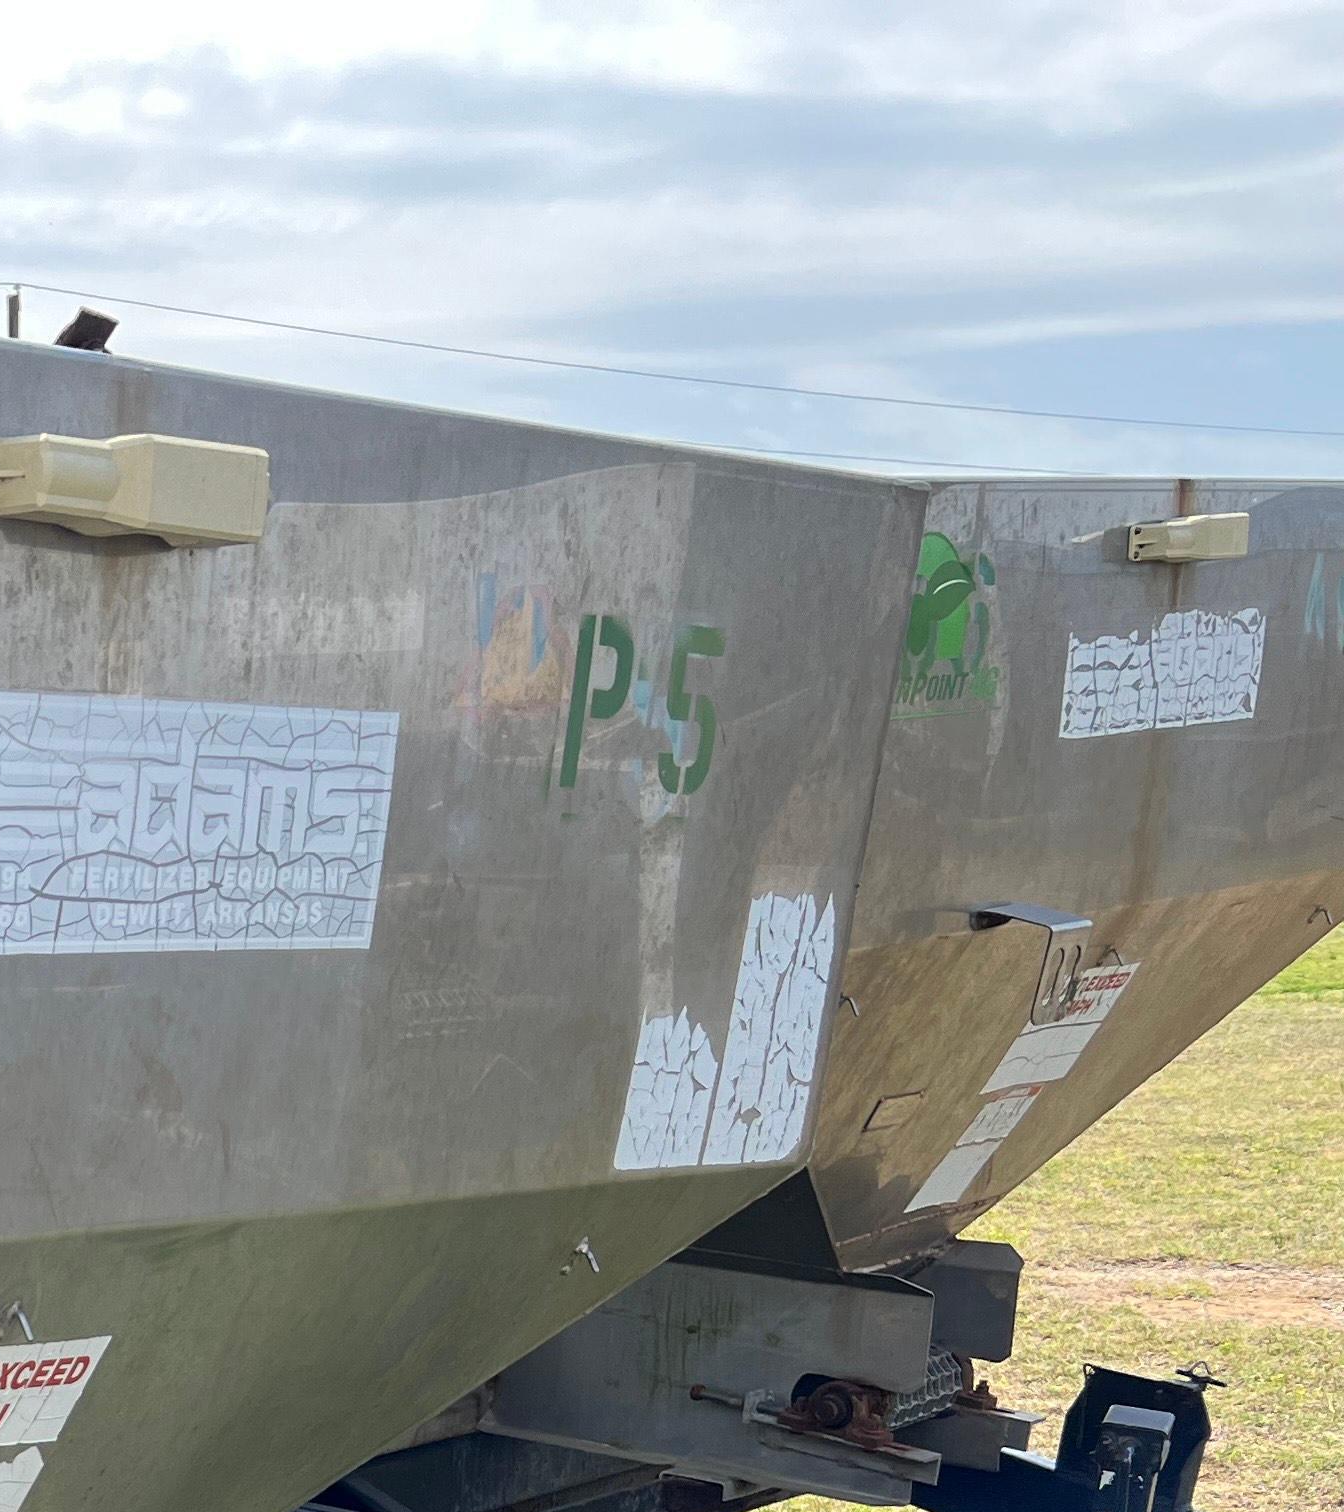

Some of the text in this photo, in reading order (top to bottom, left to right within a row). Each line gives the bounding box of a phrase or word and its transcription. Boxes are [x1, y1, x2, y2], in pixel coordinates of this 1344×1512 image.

[68, 865, 354, 890] FERTILIZER EQUIPMENT
[202, 899, 324, 924] ARKANSAS
